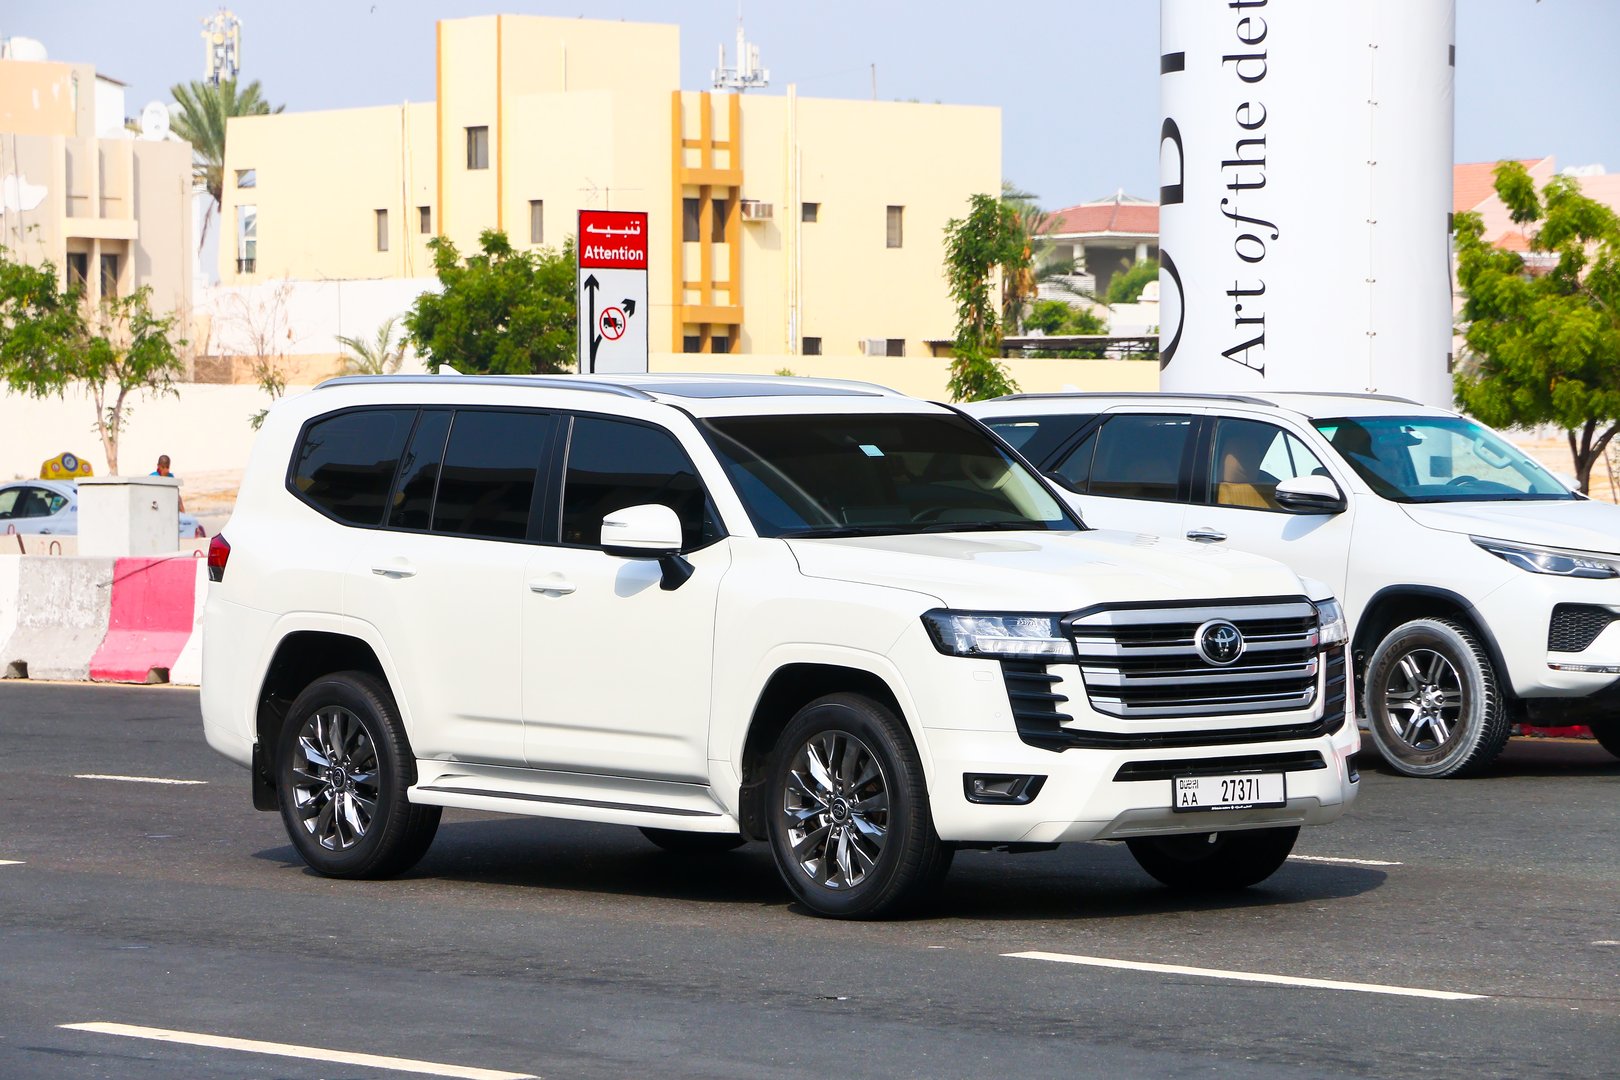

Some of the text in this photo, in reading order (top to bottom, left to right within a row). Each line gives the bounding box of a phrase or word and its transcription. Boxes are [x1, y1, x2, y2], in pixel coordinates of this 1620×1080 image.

[1221, 102, 1267, 195] the
[586, 221, 641, 238] تنبيه
[1220, 198, 1279, 263] of
[584, 245, 643, 261] Attention
[1221, 279, 1265, 379] Art
[1182, 791, 1199, 806] AA
[1221, 779, 1260, 802] 27371
